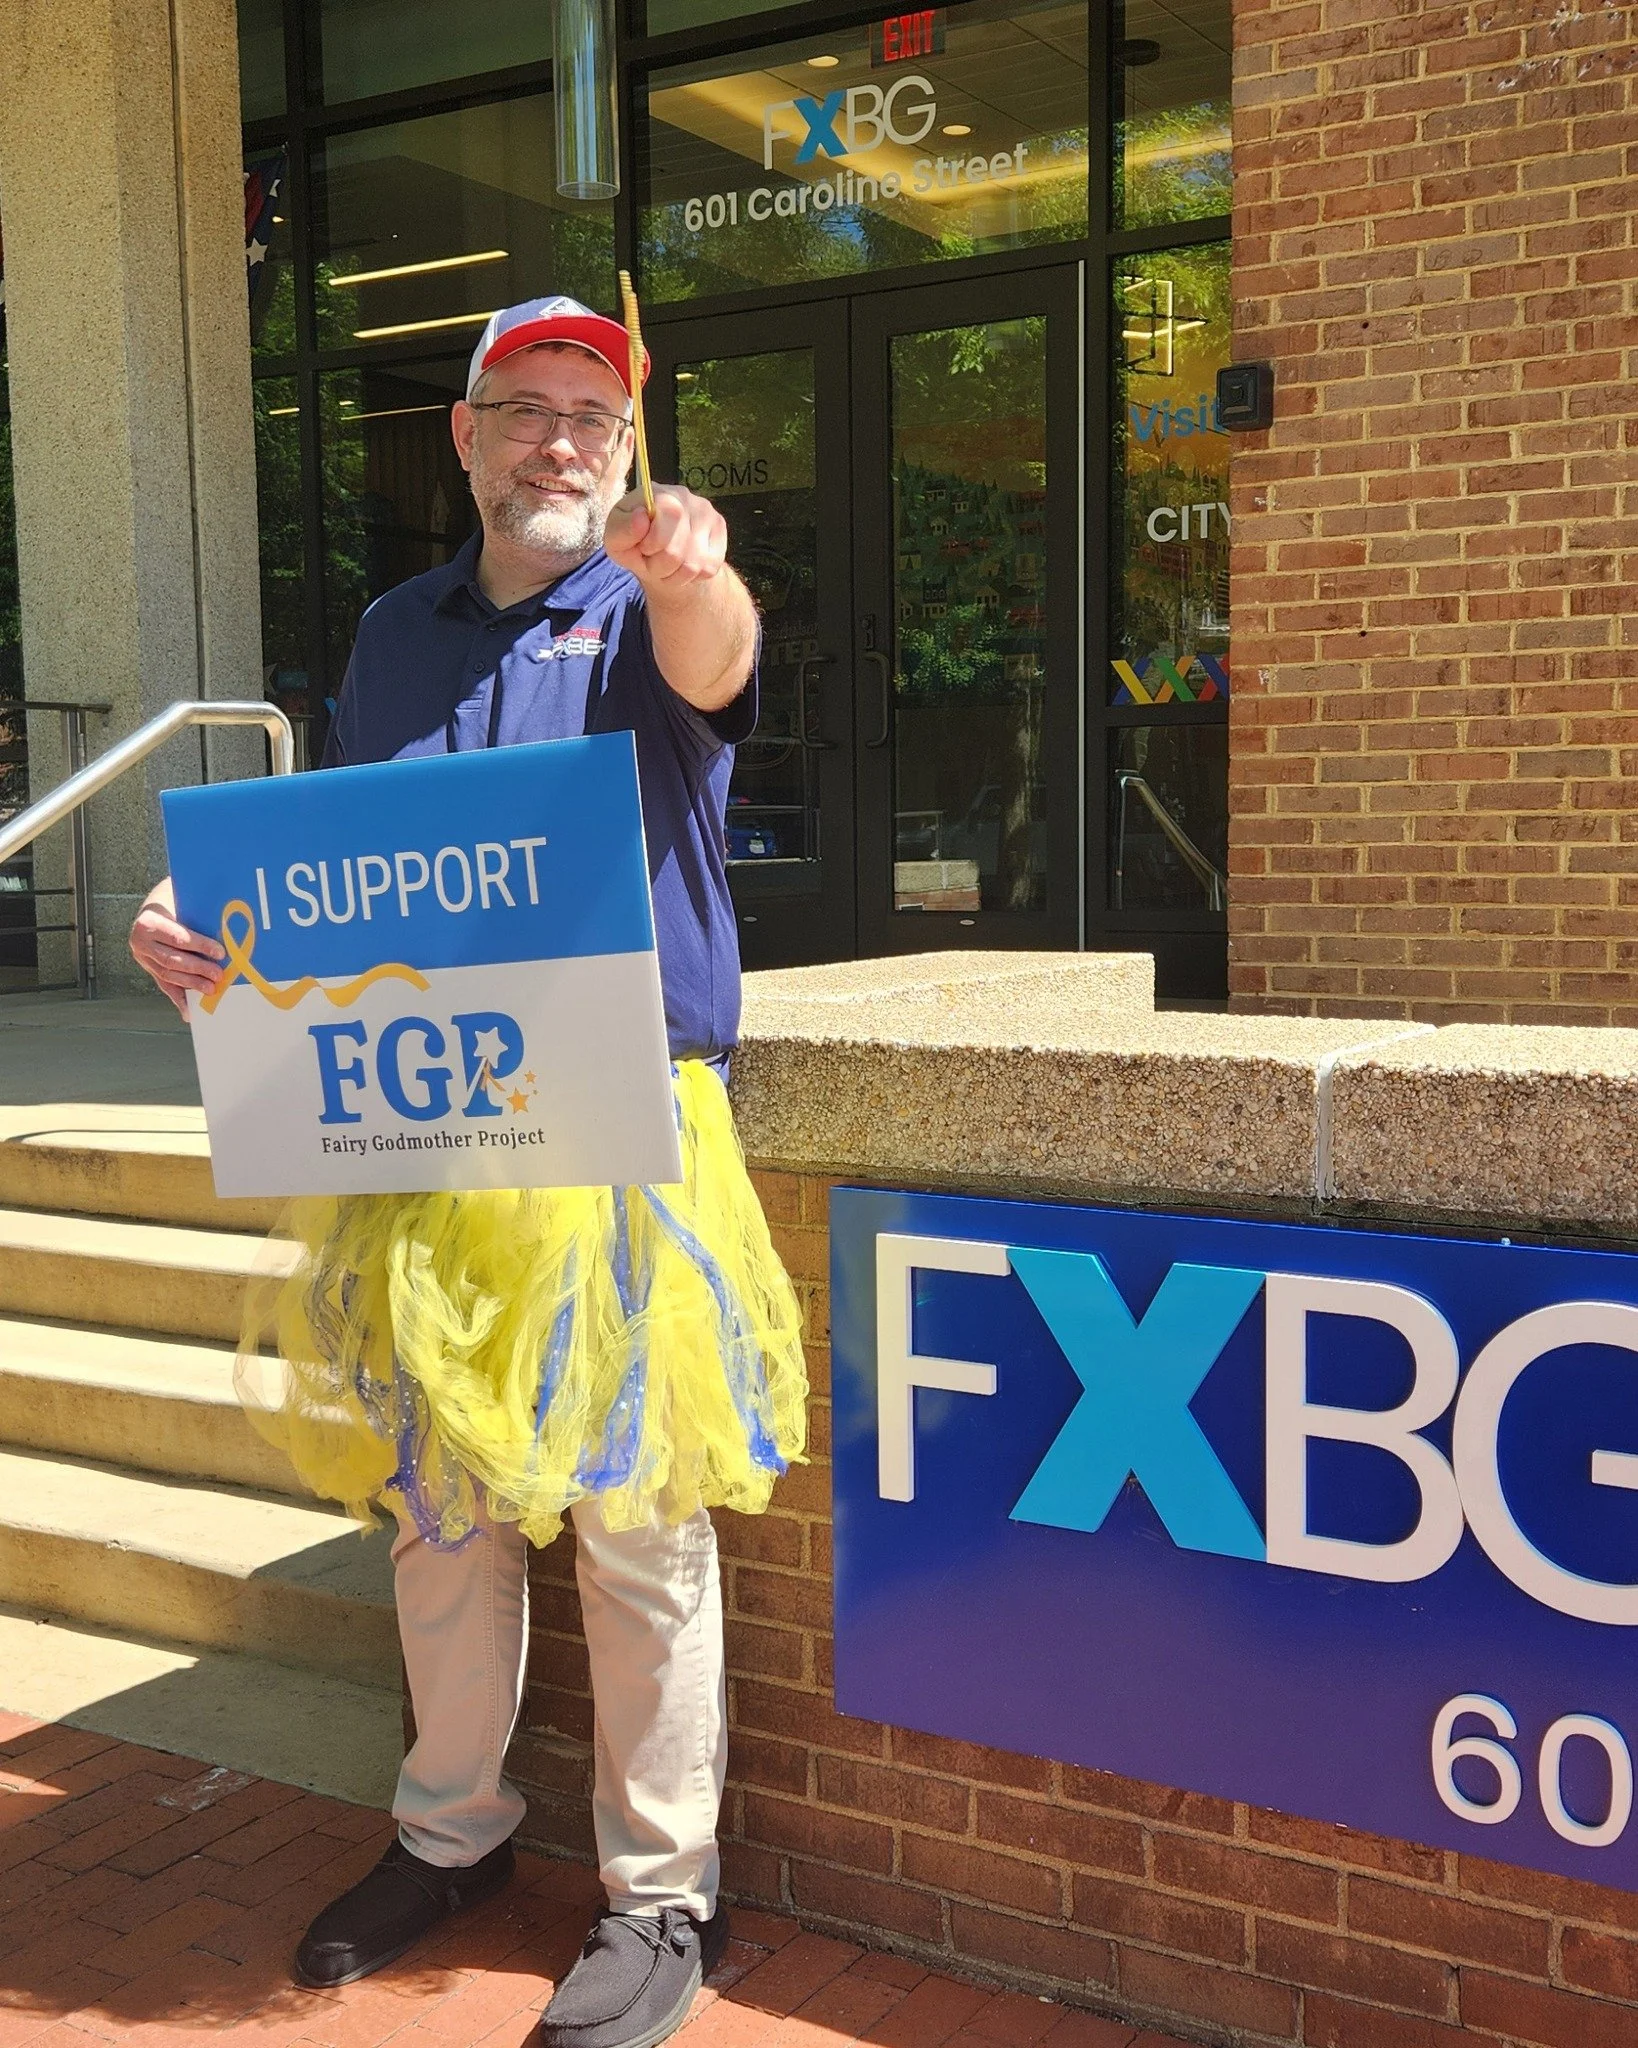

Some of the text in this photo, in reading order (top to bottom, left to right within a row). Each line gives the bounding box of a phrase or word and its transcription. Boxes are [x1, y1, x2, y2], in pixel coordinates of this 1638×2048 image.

[883, 10, 936, 62] EXIT
[764, 75, 936, 171] FXBG
[684, 142, 1029, 233] 601 Caroline Street
[683, 459, 768, 490] OOMS
[1147, 502, 1232, 543] CITY
[255, 836, 547, 931] I SUPPORT
[308, 1011, 525, 1126] FGP
[321, 1127, 546, 1156] Fairy Godmother Project
[876, 1232, 1638, 1626] FXBG
[1430, 1691, 1634, 1849] 60
